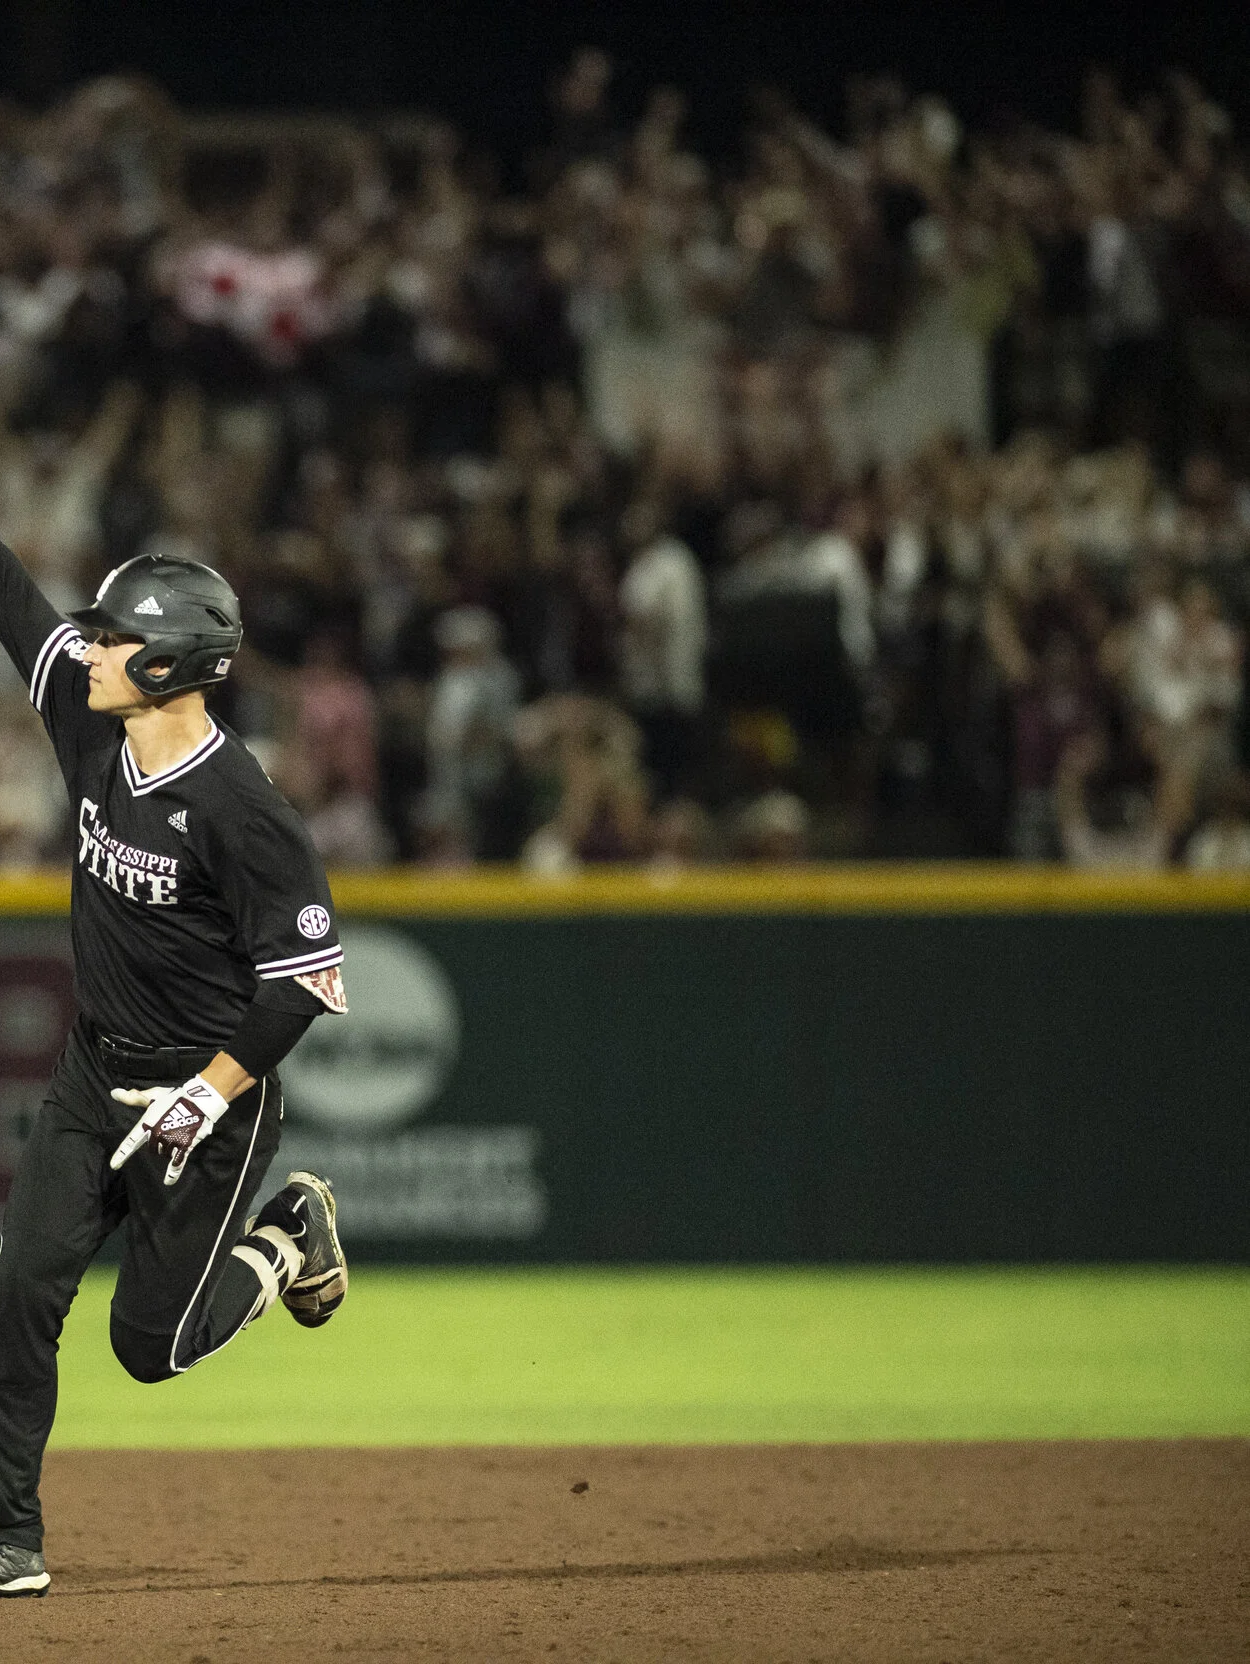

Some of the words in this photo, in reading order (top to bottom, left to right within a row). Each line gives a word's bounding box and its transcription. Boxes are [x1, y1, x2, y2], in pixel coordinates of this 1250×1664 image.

[168, 816, 188, 833] adidas
[79, 797, 178, 905] STATE
[92, 819, 178, 875] MISISSIPPI
[300, 908, 327, 936] SEC
[161, 1115, 200, 1131] adidas
